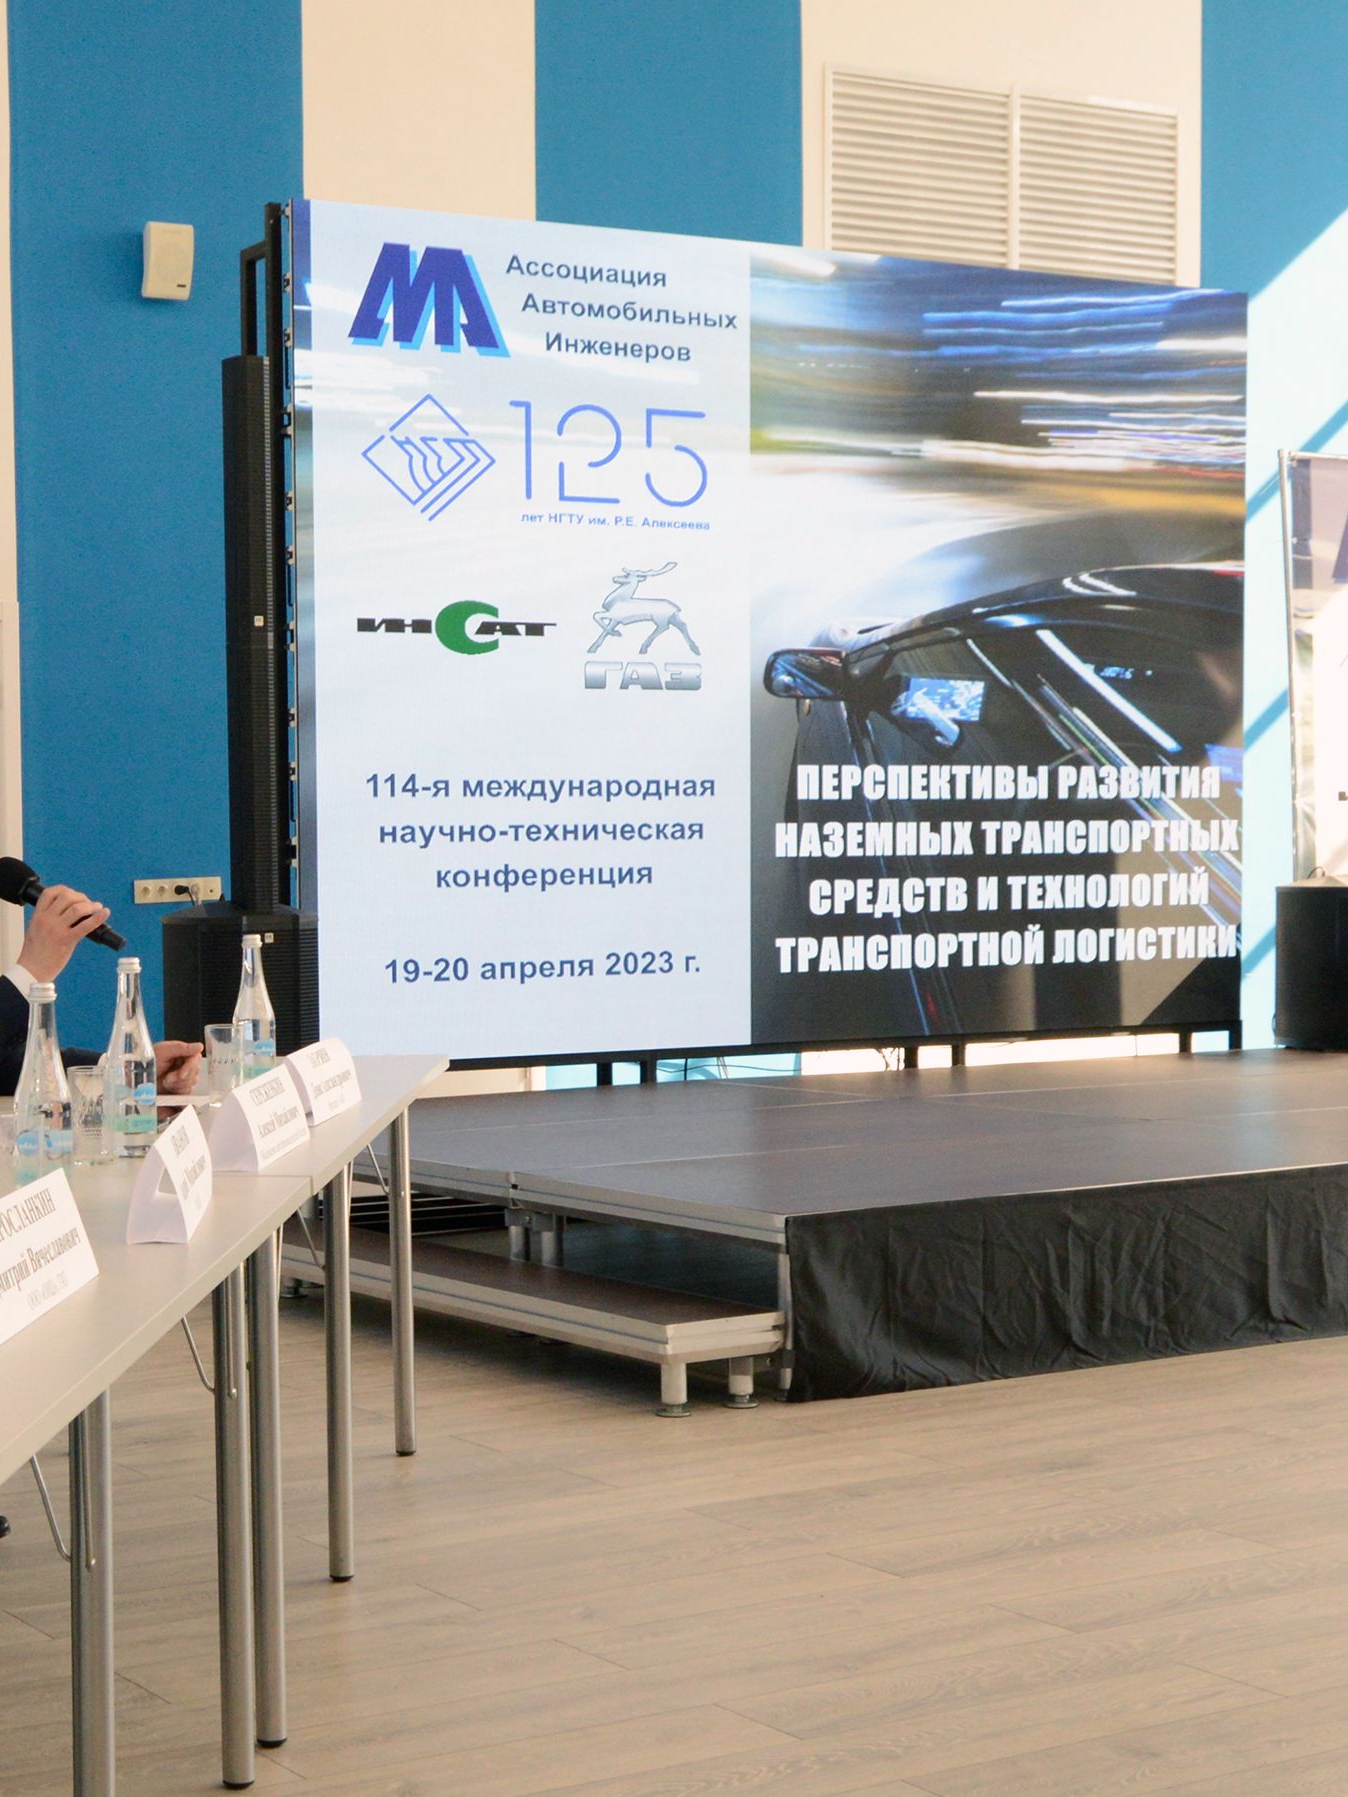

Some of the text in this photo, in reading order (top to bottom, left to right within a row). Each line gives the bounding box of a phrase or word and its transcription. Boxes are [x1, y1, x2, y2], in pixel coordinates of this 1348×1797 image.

[505, 254, 667, 288] Ассоциация
[521, 292, 738, 330] Автомобильных
[545, 332, 691, 363] Инженеров
[509, 400, 708, 507] 125
[520, 513, 544, 523] лет
[548, 513, 584, 525] НГТУ
[588, 517, 611, 526] им.
[641, 517, 710, 531] Алексеева
[584, 661, 702, 691] ГАЗ
[365, 773, 716, 802] 114-я международная
[796, 764, 1221, 801] ПЕРСПЕКТИВЫ РАЗВИТИЯ
[378, 819, 705, 849] научно-техническая
[775, 818, 1240, 858] НАЗЕМНЫХ ТРАНСПОРТНЫХ
[435, 863, 653, 893] конференция
[809, 866, 1210, 918] СРЕДСТВ И ТЕХНОЛОГИЙ
[775, 924, 1238, 973] ТРАНСПОРТНОЙ ЛОГИСТИКИ
[384, 950, 701, 985] 19-20 апреля 2023 г.
